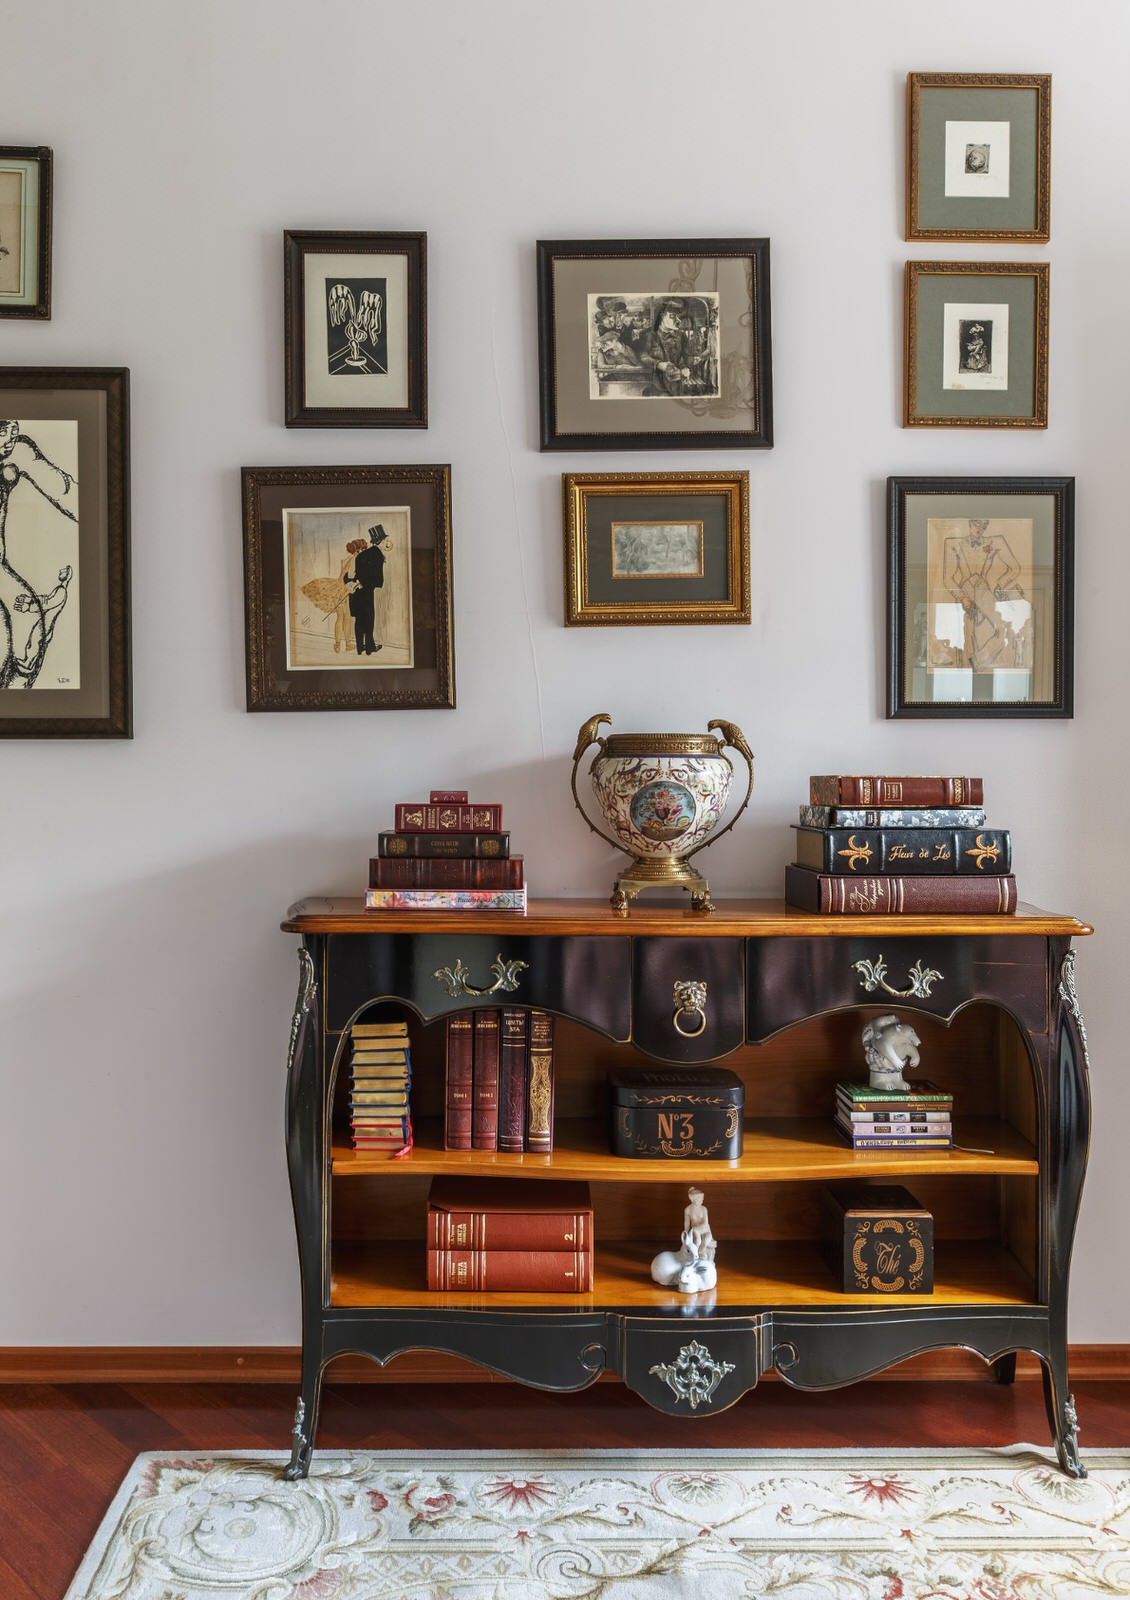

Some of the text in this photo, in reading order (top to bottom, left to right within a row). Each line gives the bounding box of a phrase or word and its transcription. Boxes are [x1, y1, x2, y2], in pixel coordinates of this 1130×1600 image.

[888, 844, 914, 862] Fleur
[932, 844, 950, 861] Lis
[563, 1233, 574, 1241] 2
[874, 1241, 902, 1275] Thé
